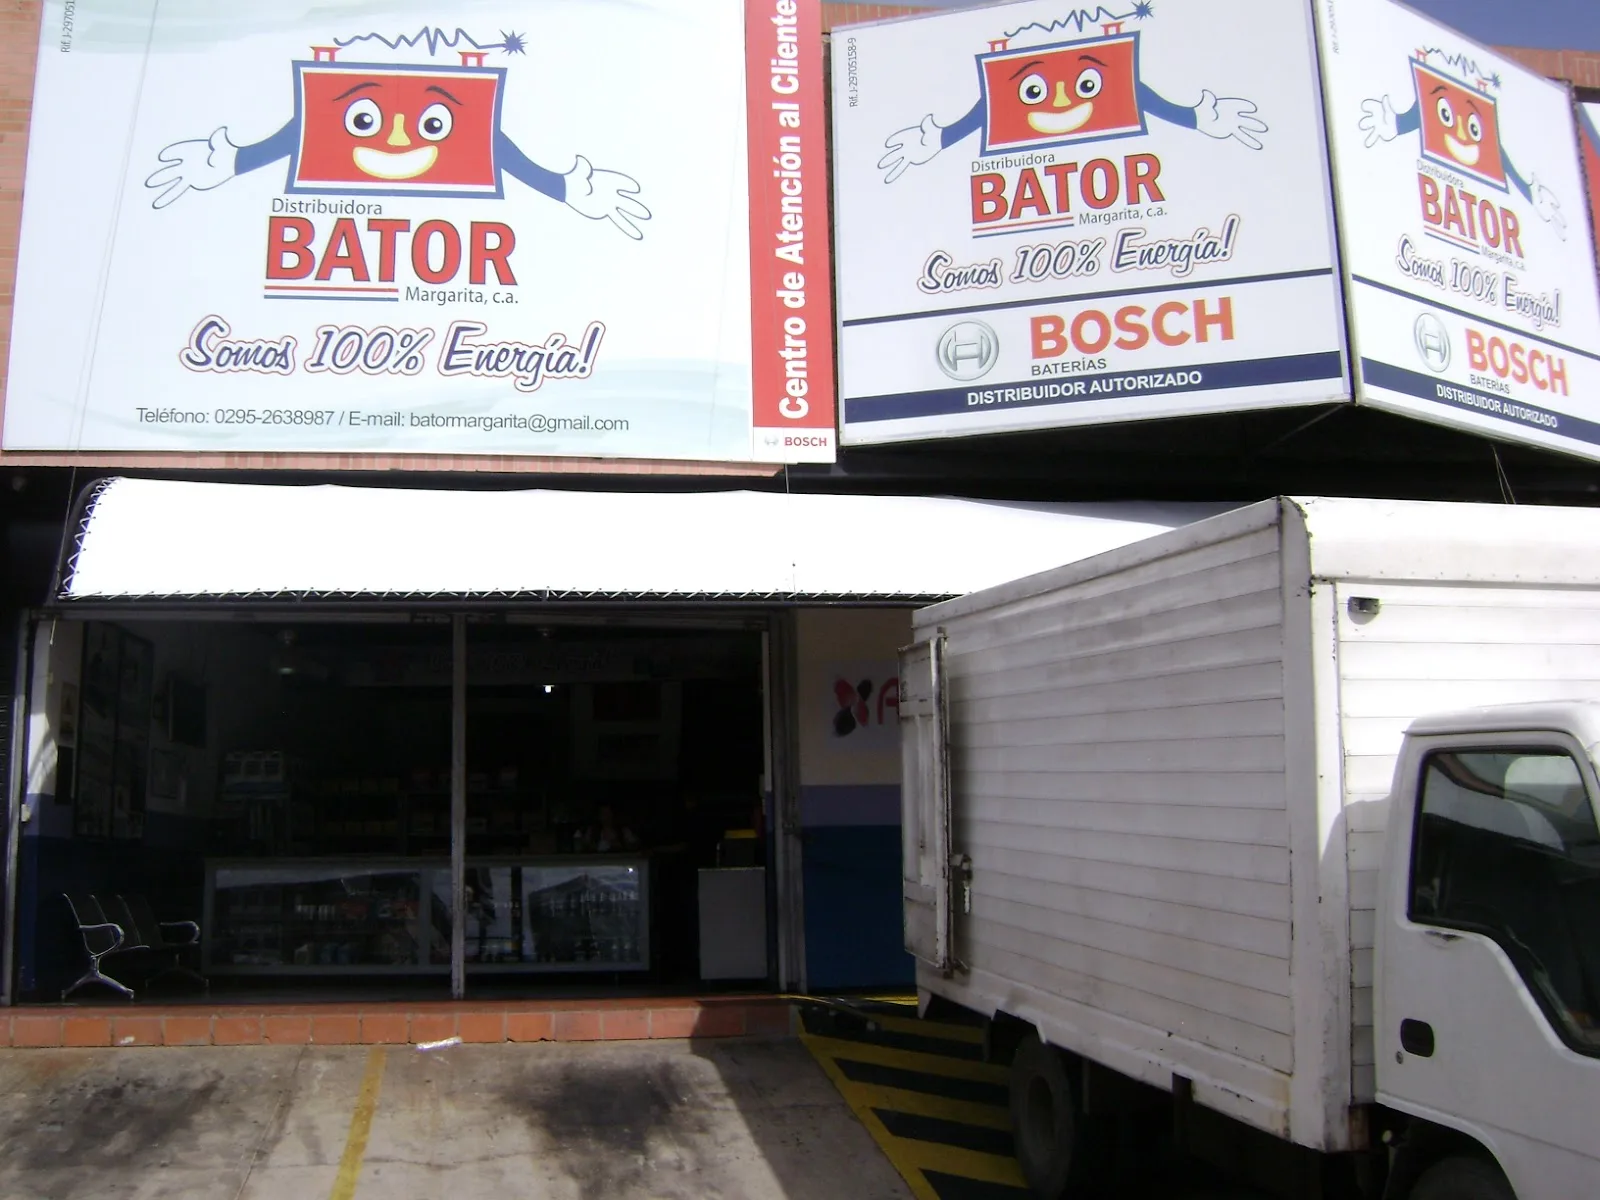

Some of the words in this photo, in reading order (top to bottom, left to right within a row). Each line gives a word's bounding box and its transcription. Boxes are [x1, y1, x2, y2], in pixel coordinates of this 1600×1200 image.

[770, 0, 799, 94] Cliente
[847, 37, 858, 94] J-29705158-9
[771, 102, 801, 128] al
[971, 152, 1056, 173] Distribuidora
[1416, 159, 1464, 188] Distribuidora
[271, 198, 383, 215] Distribuidora
[773, 136, 804, 264] Atención
[969, 153, 1166, 224] BATOR
[1079, 208, 1144, 226] Margarita,
[1146, 206, 1168, 218] c.a.
[1417, 173, 1525, 258] BATOR
[265, 216, 518, 286] BATOR
[917, 251, 1003, 294] Somos
[1010, 237, 1105, 283] 100%
[1111, 215, 1239, 277] Energía!
[405, 286, 488, 305] Margarita,
[492, 290, 519, 304] c.a.
[775, 271, 806, 308] de
[1396, 234, 1446, 288] Somos
[1451, 257, 1498, 305] 100%
[1503, 271, 1561, 330] Energía!
[1030, 296, 1235, 360] BOSCH
[181, 316, 295, 374] Somos
[306, 326, 434, 374] 100%
[439, 321, 605, 391] Energía!
[778, 316, 809, 419] Centro
[1031, 358, 1107, 377] BATERÍAS
[1465, 328, 1569, 397] BOSCH
[966, 380, 1086, 406] DISTRIBUIDOR
[1090, 370, 1203, 394] AUTORIZADO
[1436, 384, 1502, 413] DISTRIBUIDOR
[1502, 400, 1558, 428] AUTORIZADO
[1469, 374, 1510, 395] BATERÍAS
[136, 407, 210, 425] Teléfono:
[214, 409, 335, 426] 0295-2638987
[349, 410, 408, 427] E-mail:
[410, 413, 630, 433] batormargarita@gmail.com
[784, 436, 828, 447] BOSCH
